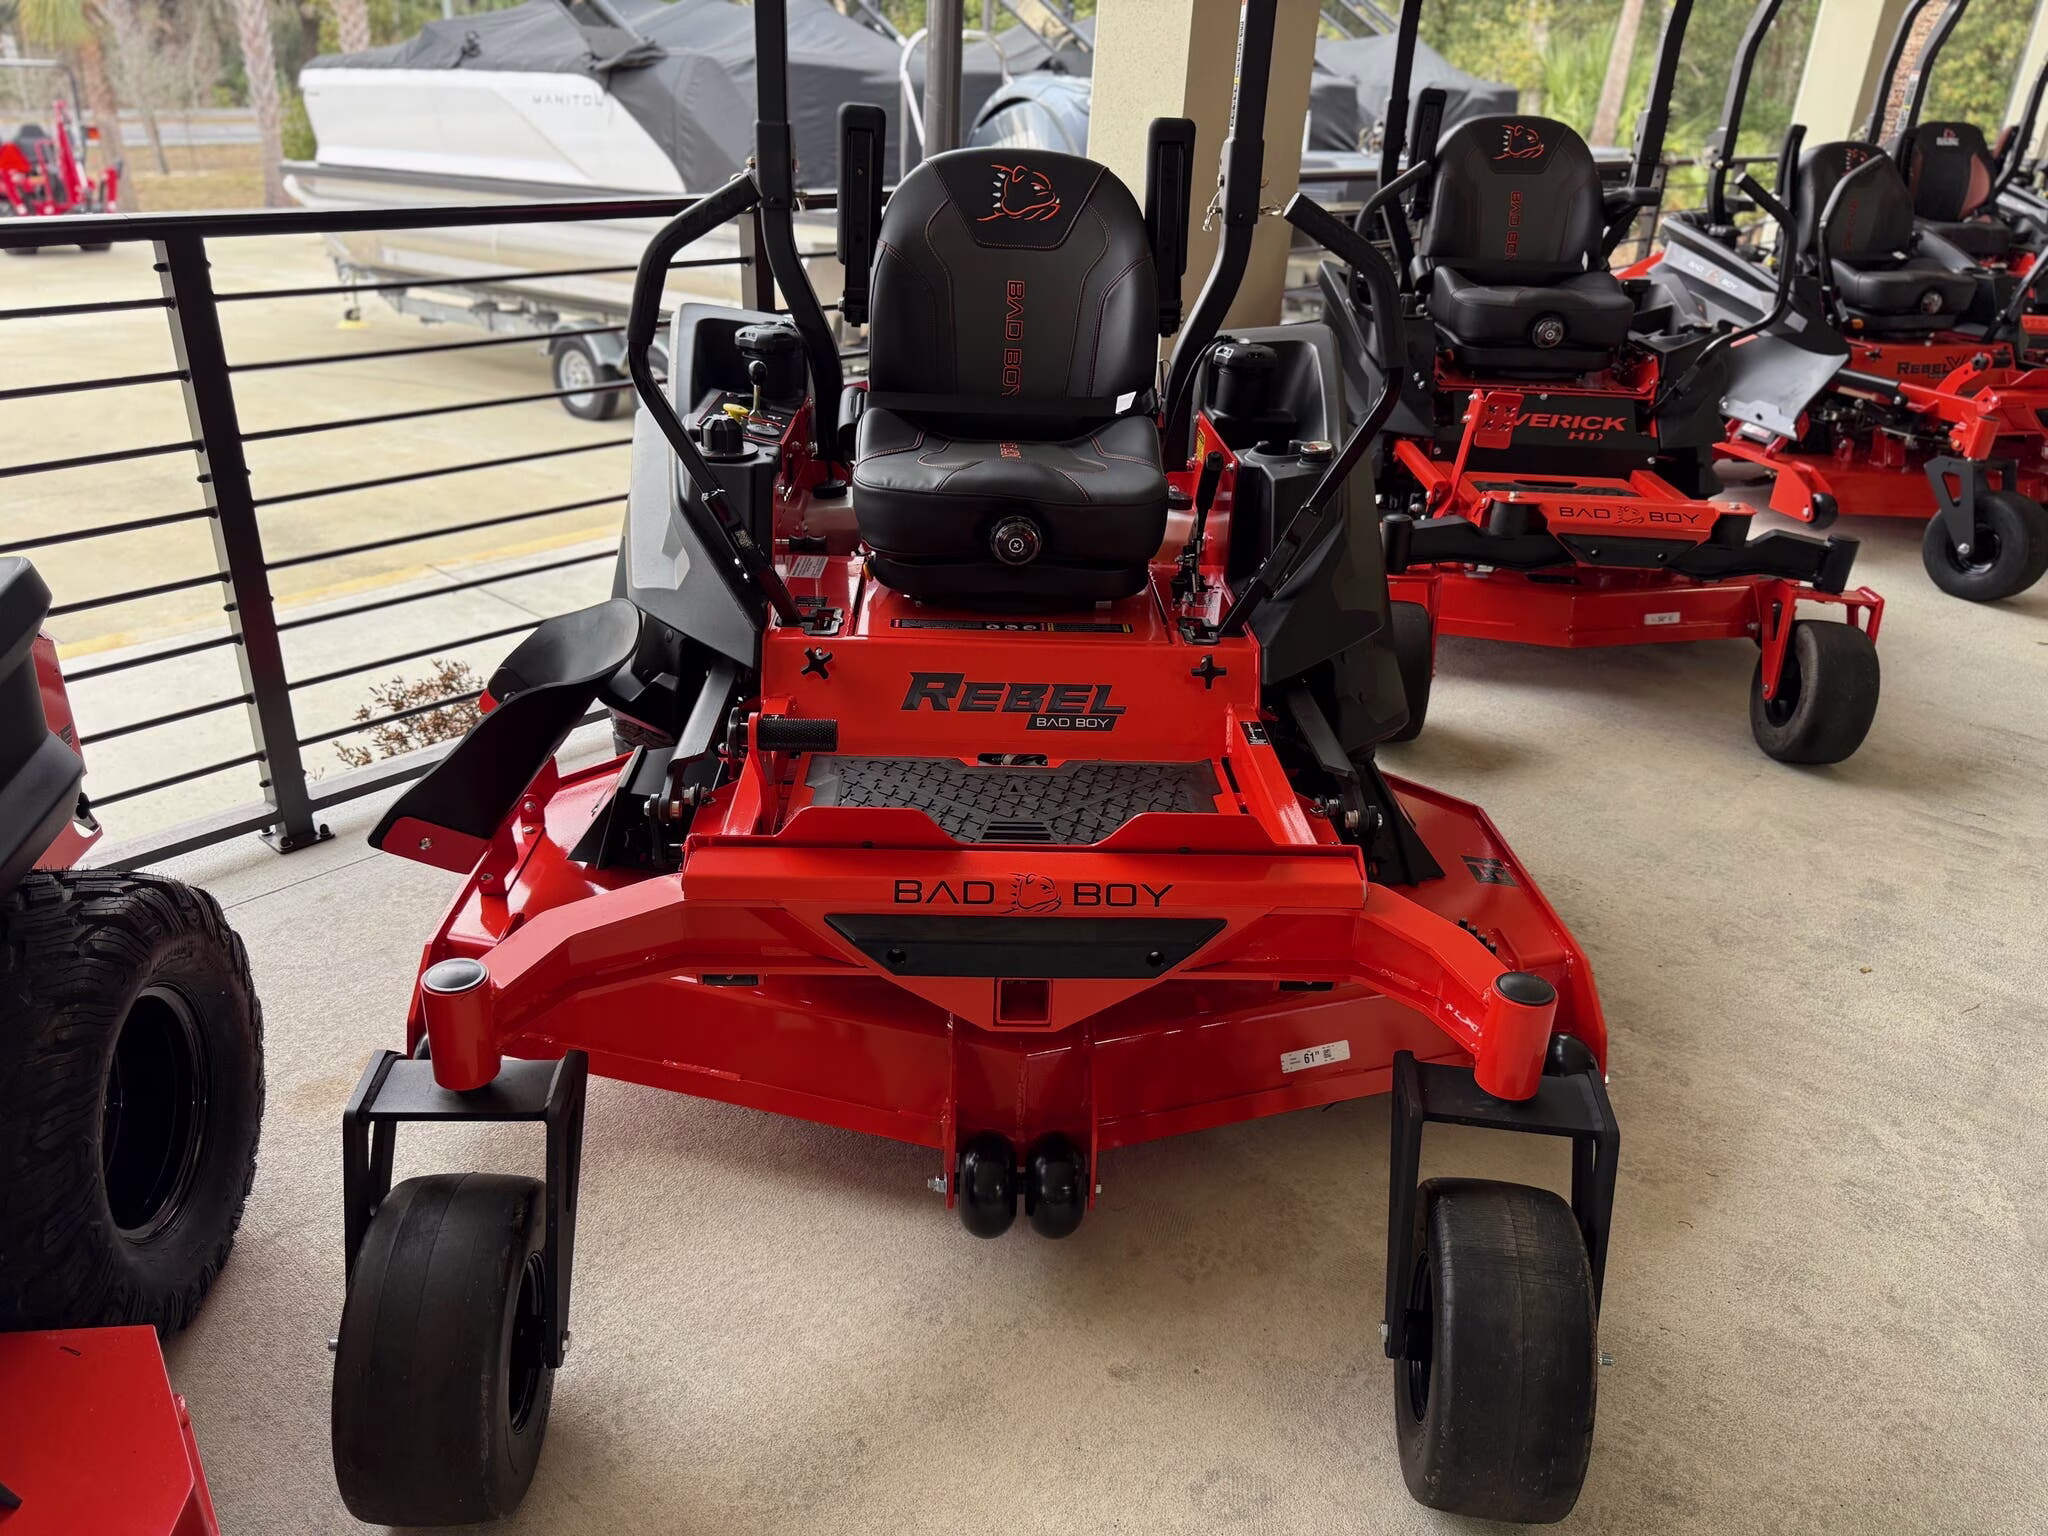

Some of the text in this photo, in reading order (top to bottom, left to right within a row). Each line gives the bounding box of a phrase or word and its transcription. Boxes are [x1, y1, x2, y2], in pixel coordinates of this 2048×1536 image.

[1505, 190, 1522, 259] BAD BO
[1005, 280, 1025, 341] BAD
[1514, 413, 1628, 431] VERICK
[1559, 506, 1700, 524] BAD BOY
[901, 672, 1127, 714] REBEL
[1036, 717, 1110, 728] BAD BOY
[894, 879, 1174, 907] BAD BOY
